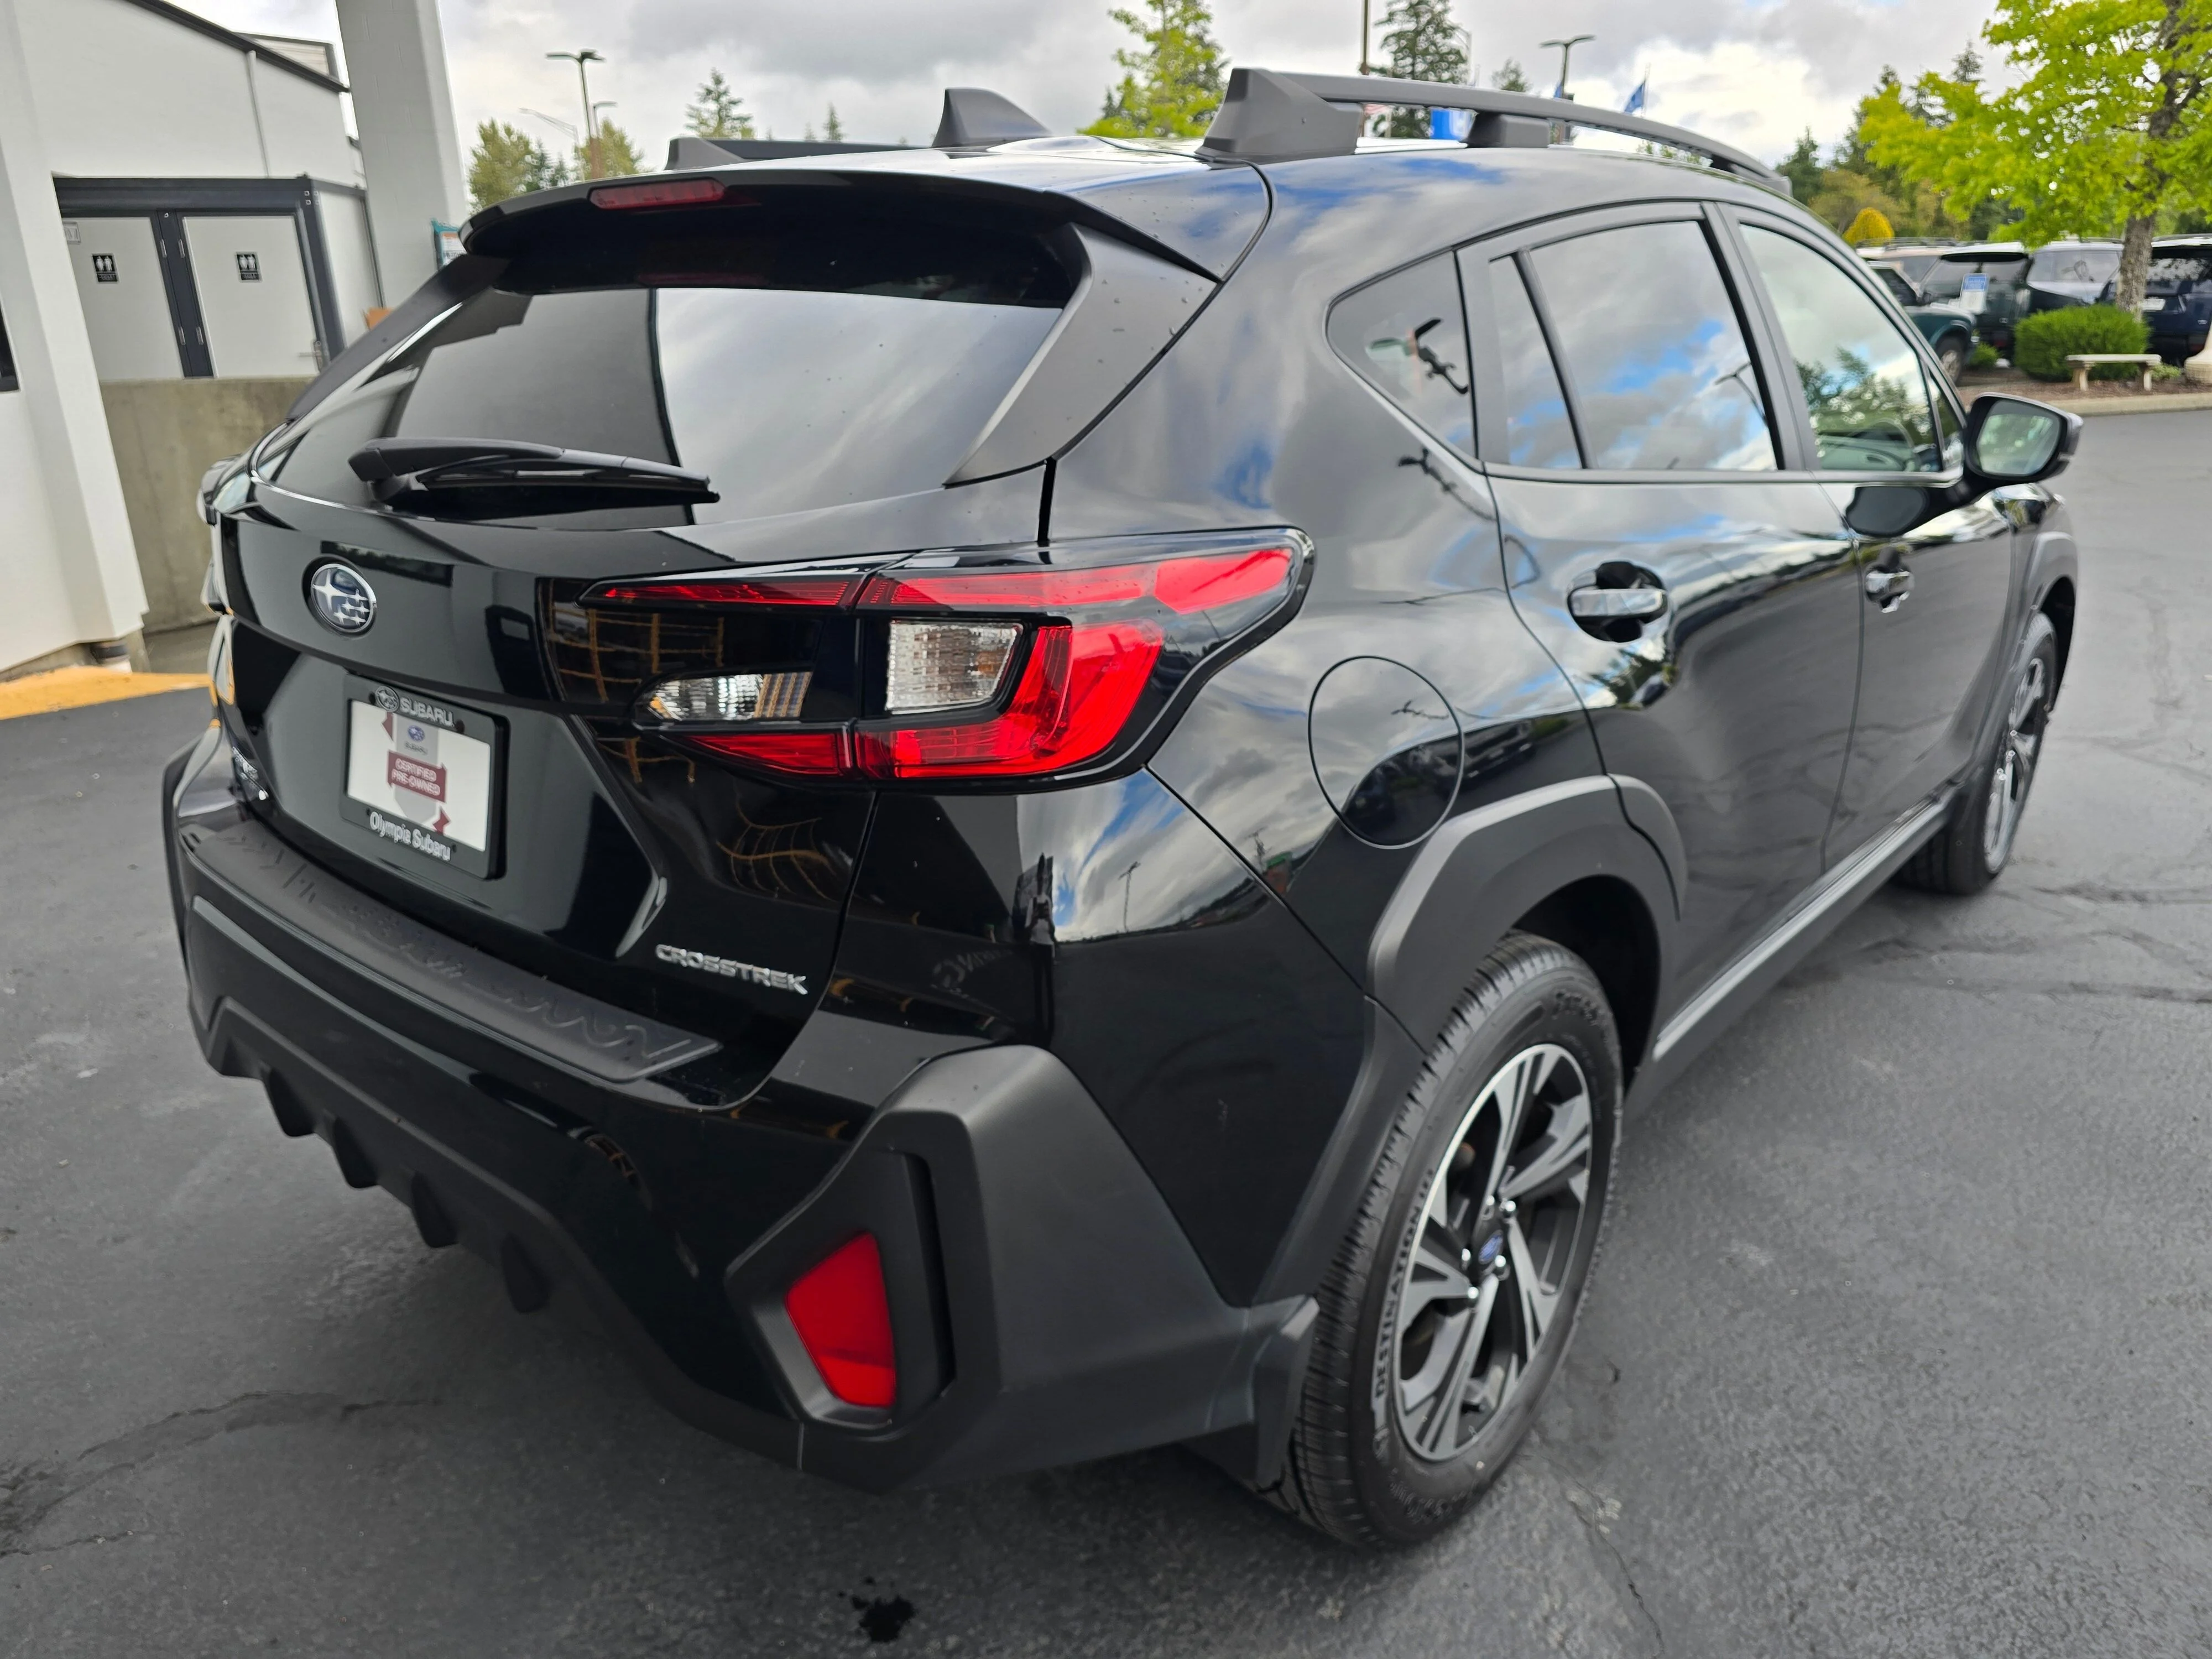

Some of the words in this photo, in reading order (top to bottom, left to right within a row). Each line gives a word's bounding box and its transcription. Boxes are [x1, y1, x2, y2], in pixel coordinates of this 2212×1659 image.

[399, 697, 453, 727] SUBARU
[391, 768, 441, 796] PRE-OWNED
[395, 758, 437, 782] CERTIFIED
[370, 811, 411, 846] Olympia
[412, 828, 451, 861] Subaru
[656, 943, 808, 995] CROSSTREK
[1375, 1206, 1421, 1399] DESTINATION
